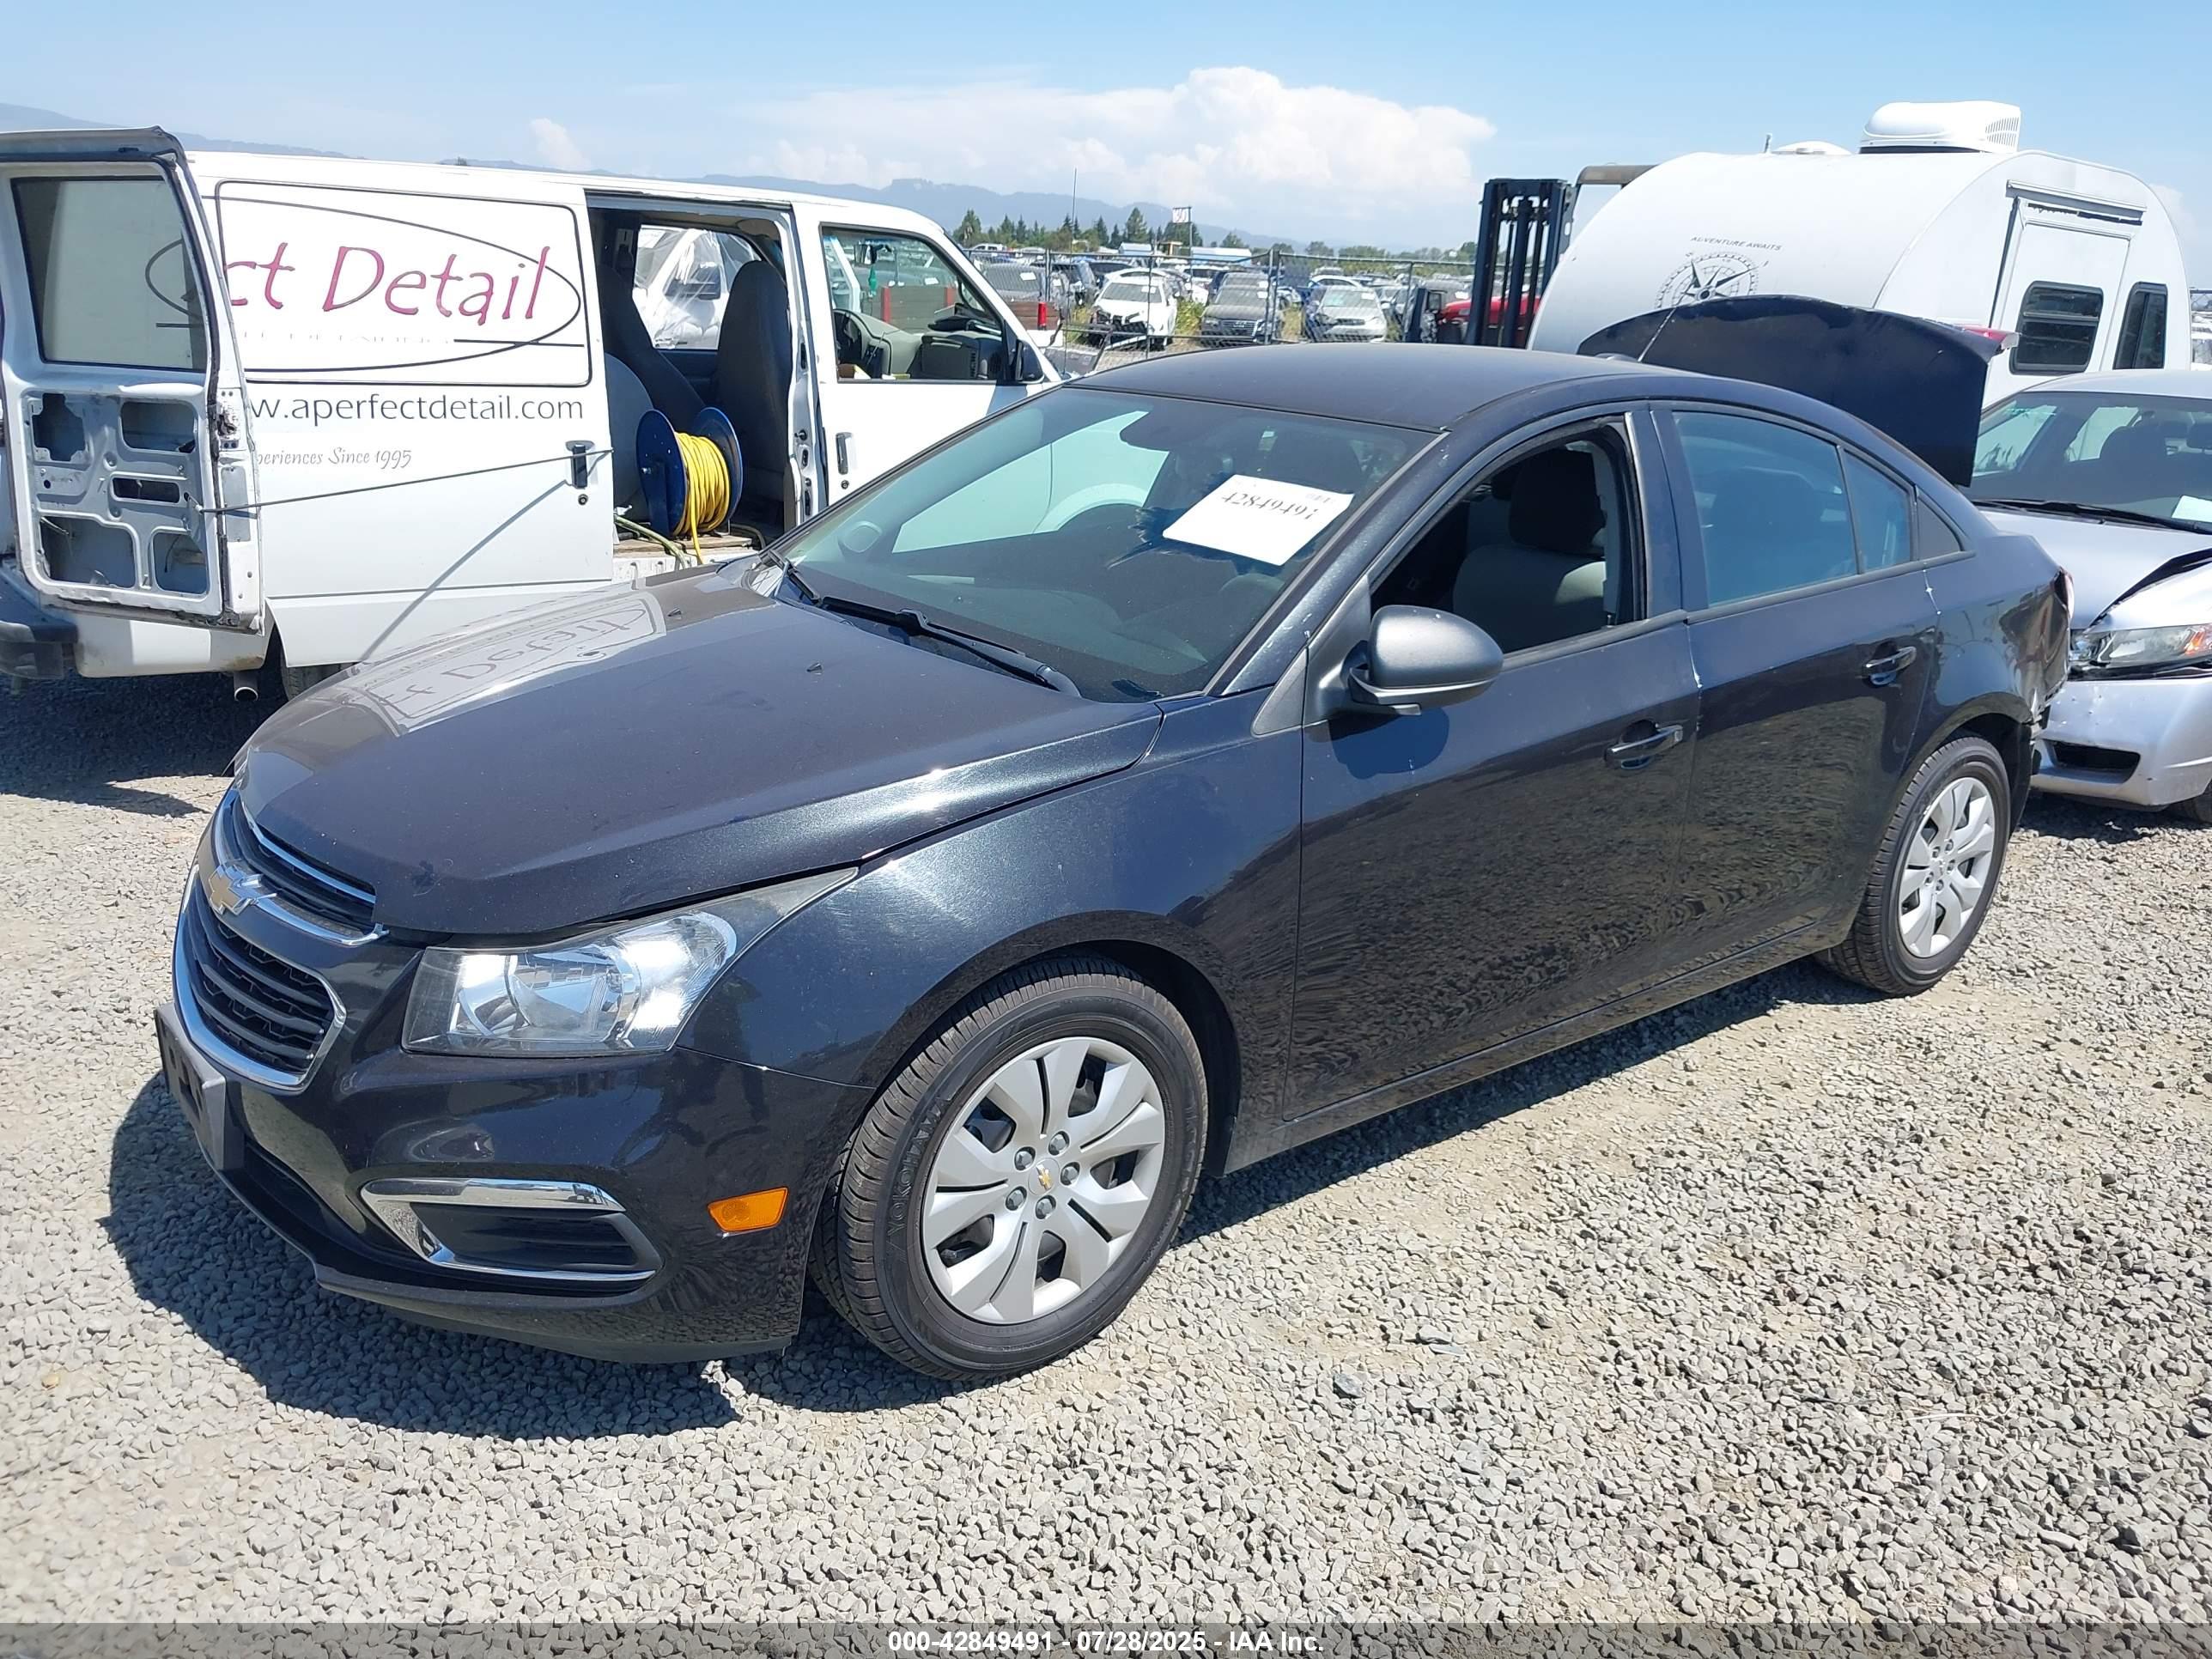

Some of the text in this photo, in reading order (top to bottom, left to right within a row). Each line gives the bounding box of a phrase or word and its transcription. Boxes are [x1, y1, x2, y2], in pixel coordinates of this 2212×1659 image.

[1691, 237, 1746, 246] ADVENTURE
[321, 246, 550, 326] Detail
[250, 392, 584, 427] w.aperfectdetail.com
[328, 447, 370, 465] Since
[375, 449, 412, 470] 1995
